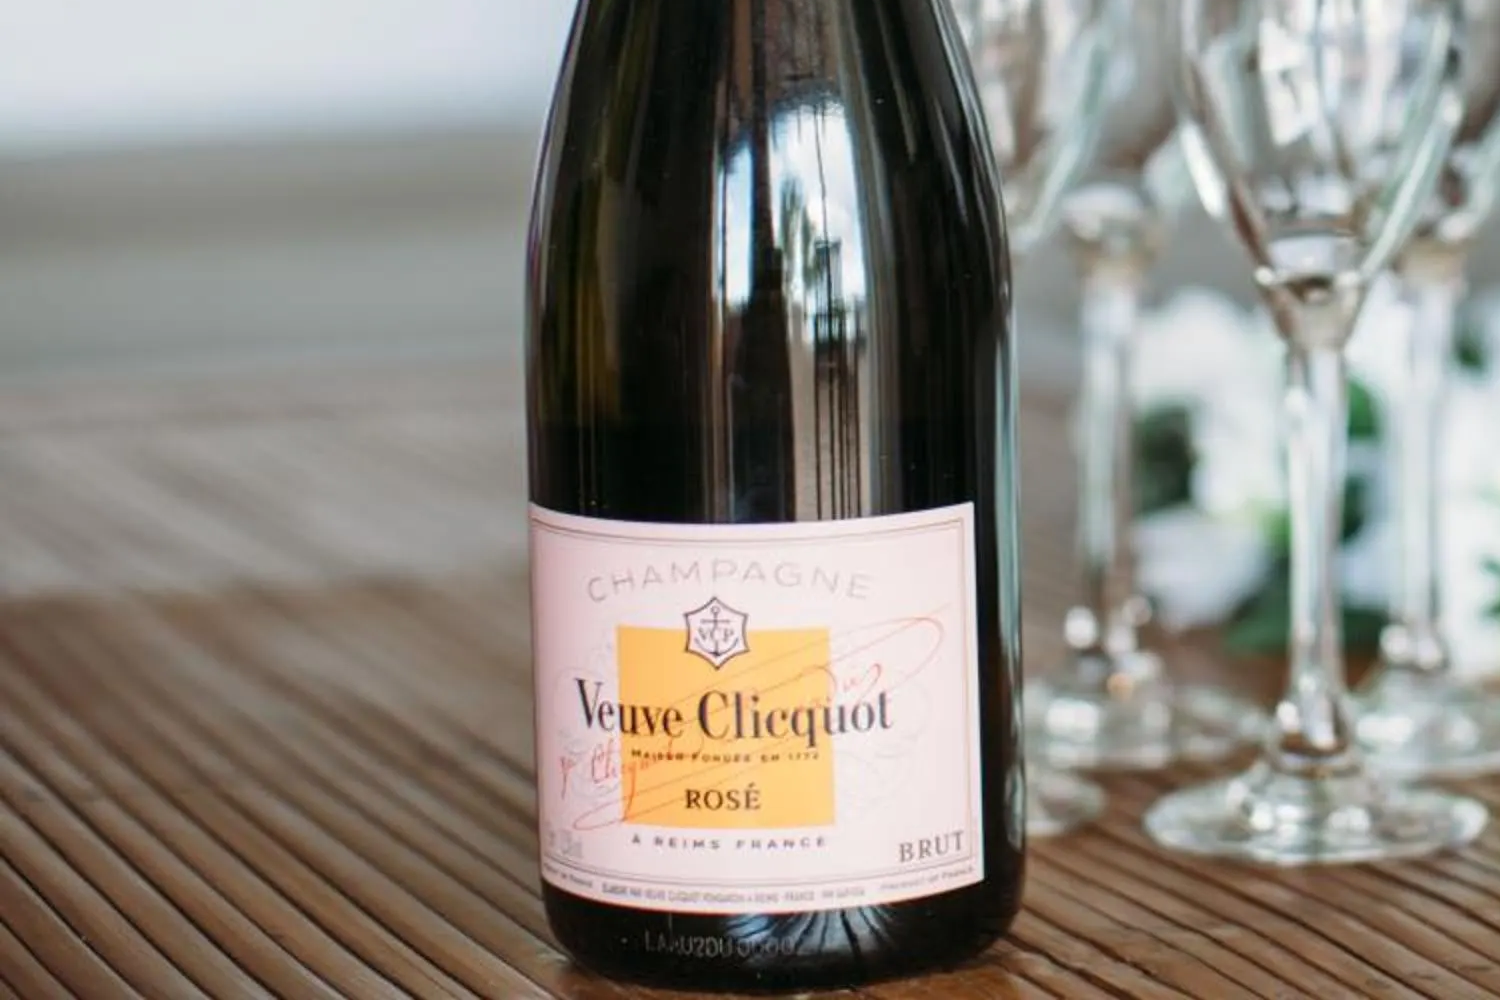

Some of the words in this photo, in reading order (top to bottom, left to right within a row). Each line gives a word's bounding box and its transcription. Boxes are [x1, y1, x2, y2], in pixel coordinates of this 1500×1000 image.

[586, 557, 875, 602] CHAMPAGNE
[574, 676, 684, 739] Veuve
[696, 689, 893, 749] Clicquot
[684, 782, 762, 812] ROSÉ
[653, 835, 721, 850] REIMS
[734, 835, 827, 850] FRANCE
[898, 829, 965, 864] BRUT
